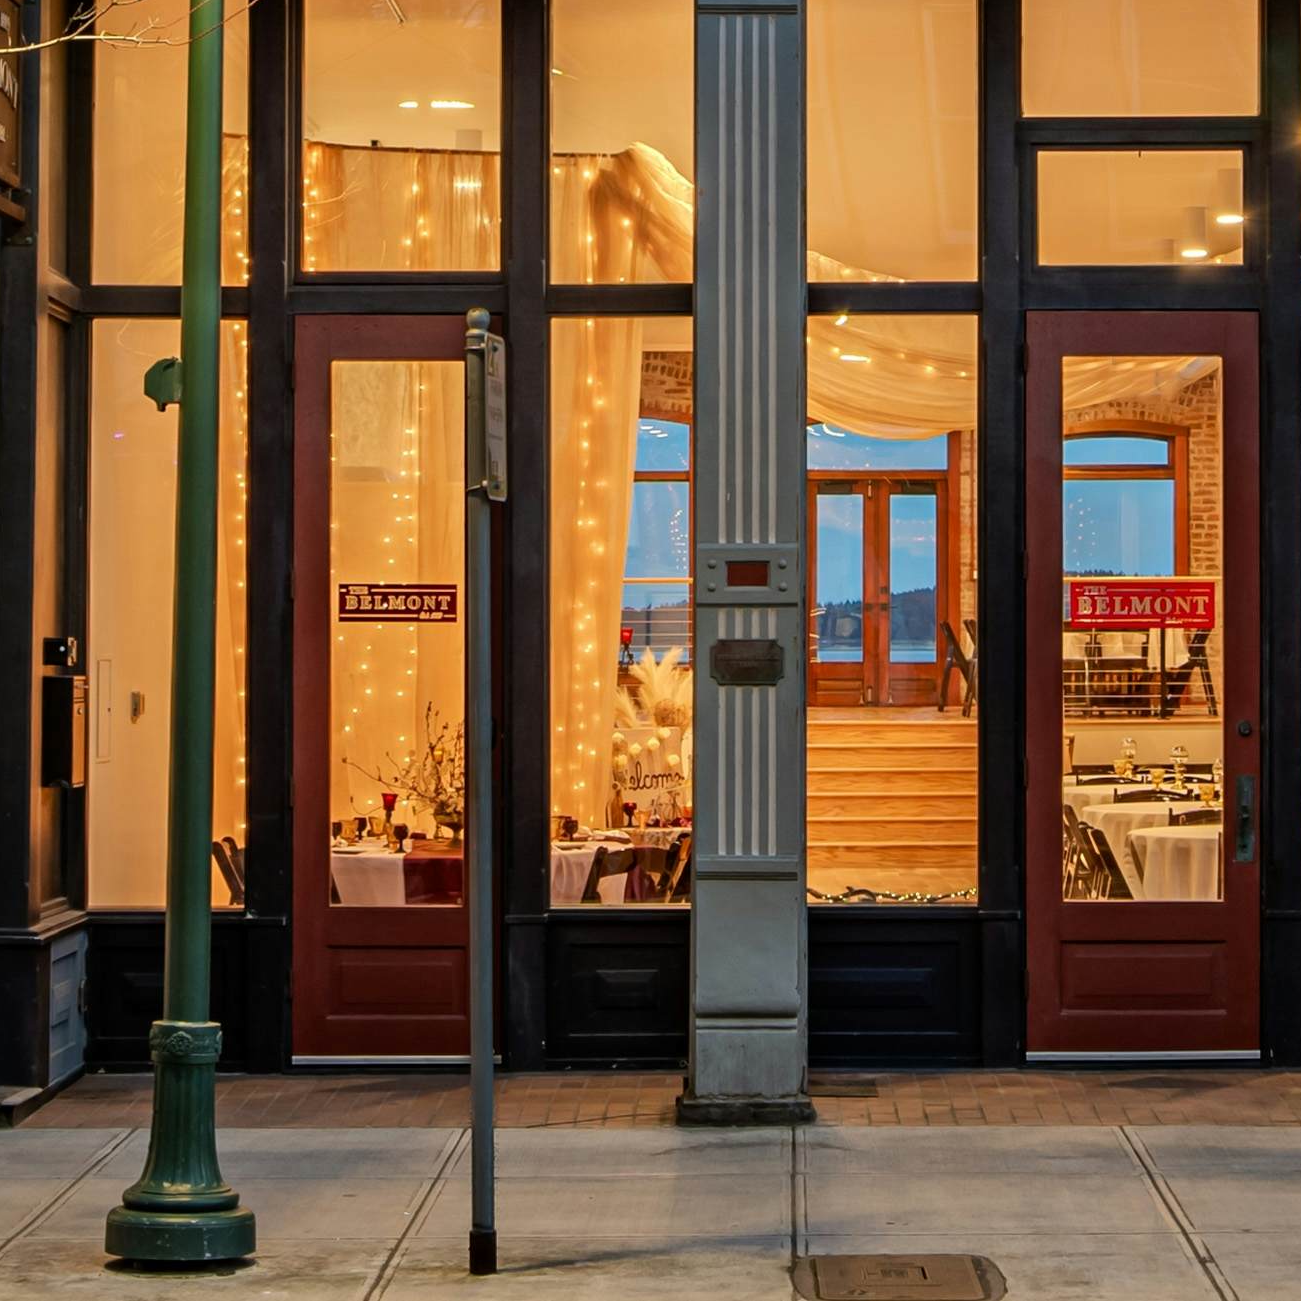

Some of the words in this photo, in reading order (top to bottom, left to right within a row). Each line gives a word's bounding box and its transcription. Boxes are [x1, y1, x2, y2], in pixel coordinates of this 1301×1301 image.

[1083, 585, 1108, 596] THE
[345, 595, 451, 610] BELMONT
[1077, 596, 1210, 615] BELMONT
